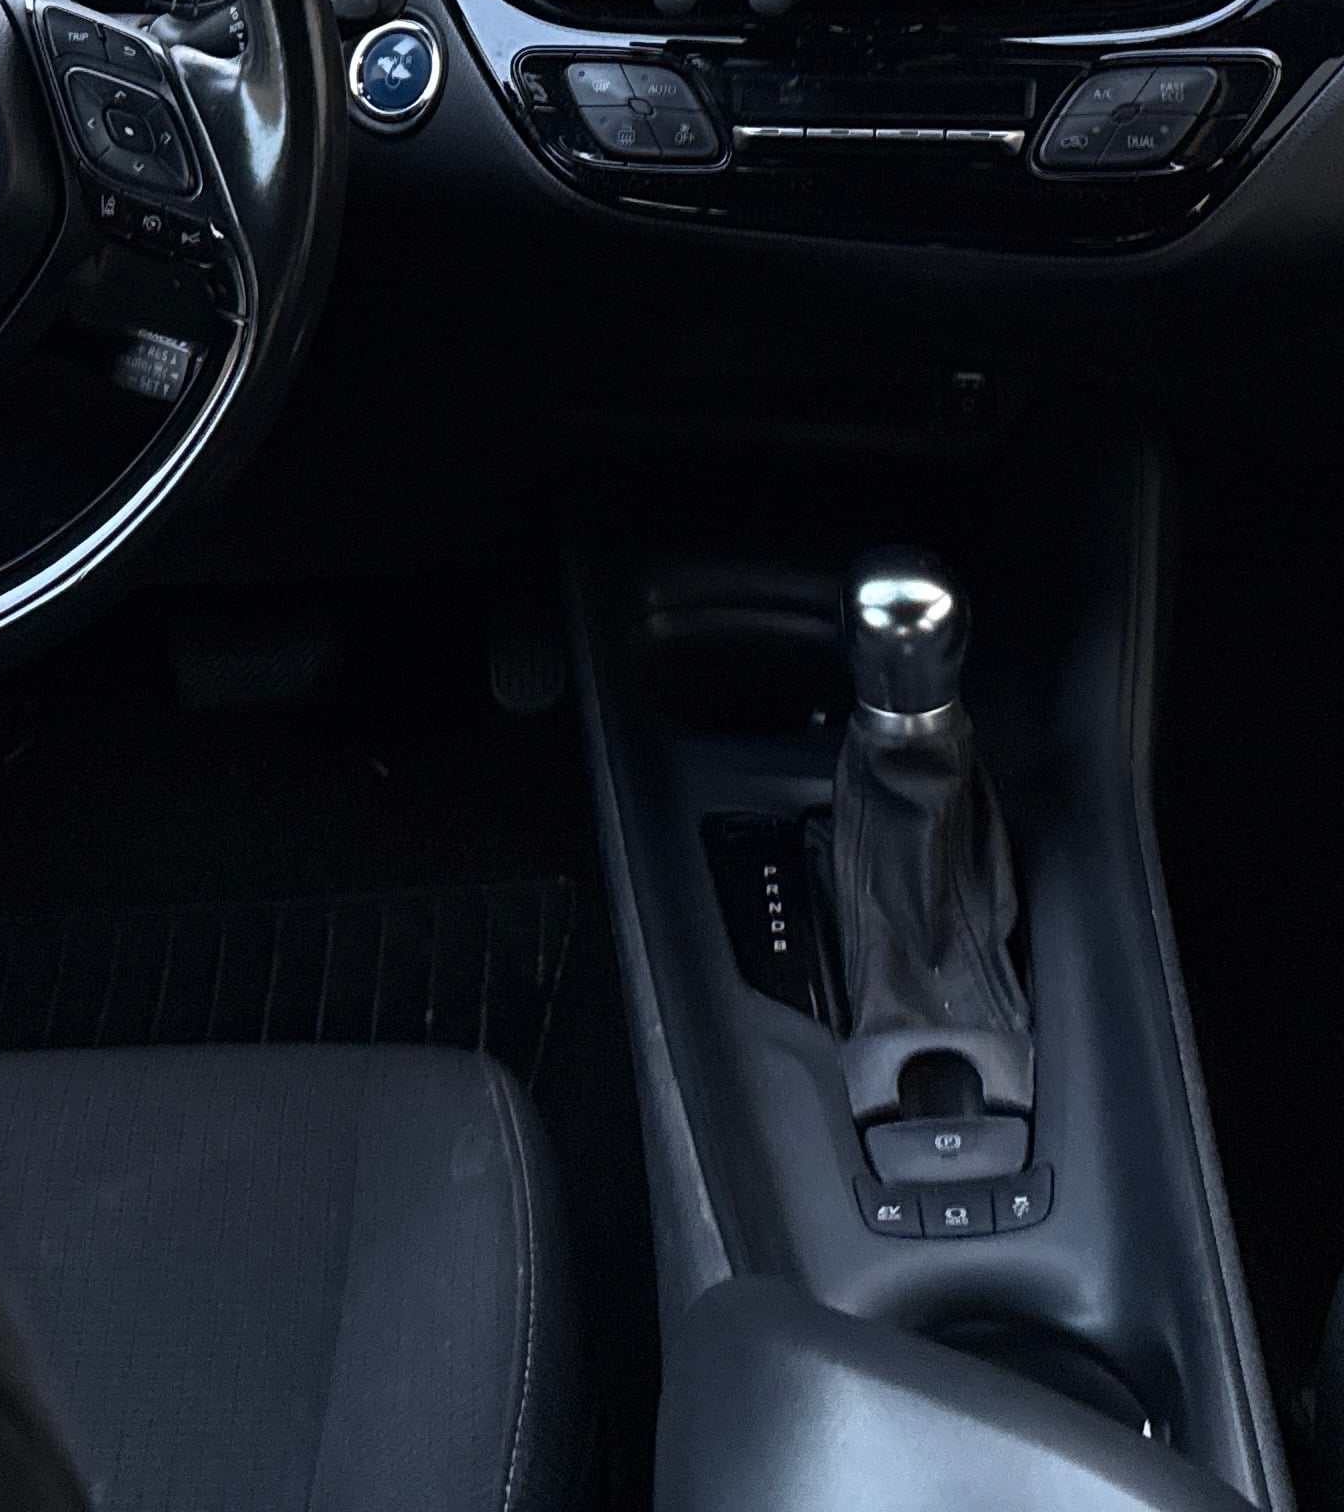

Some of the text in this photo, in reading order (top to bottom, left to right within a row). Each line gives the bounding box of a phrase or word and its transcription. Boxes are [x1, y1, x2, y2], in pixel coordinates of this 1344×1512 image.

[67, 30, 89, 43] TRIP
[647, 84, 677, 96] AUTO
[1093, 89, 1112, 99] A/C
[674, 132, 696, 144] OFF
[1127, 136, 1155, 149] DUAL
[763, 864, 778, 879] P
[766, 883, 779, 896] R
[768, 901, 783, 914] N
[771, 919, 785, 933] D
